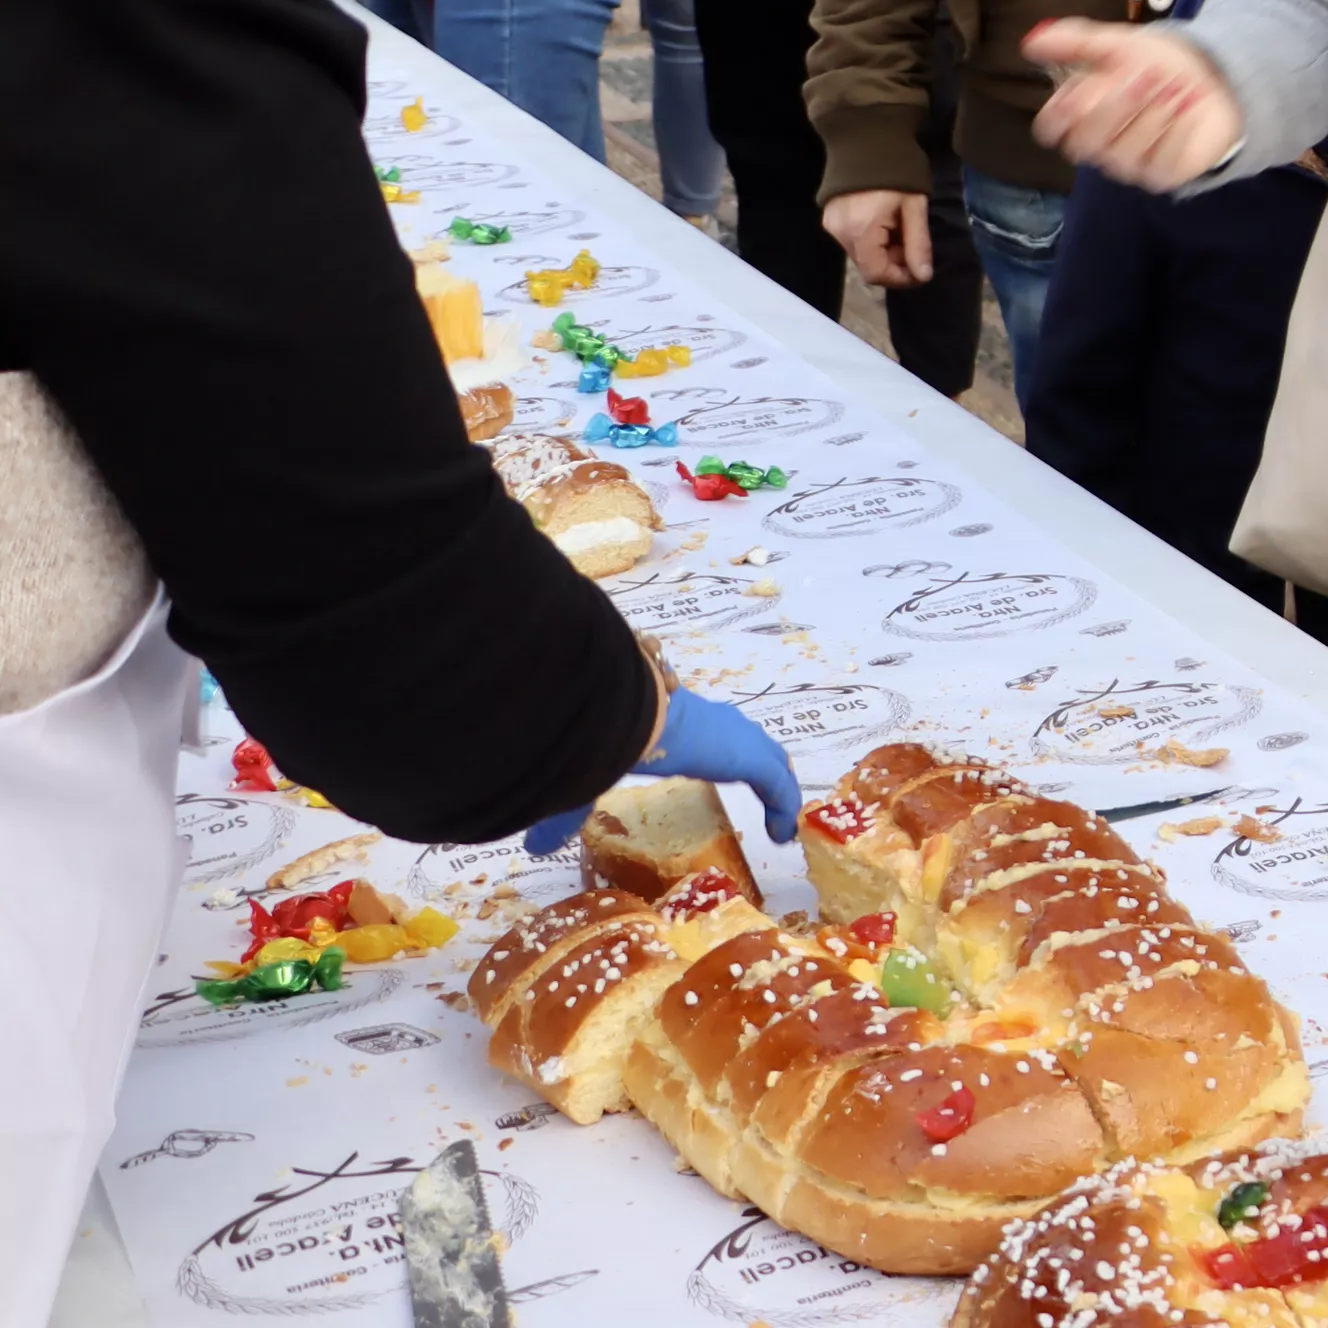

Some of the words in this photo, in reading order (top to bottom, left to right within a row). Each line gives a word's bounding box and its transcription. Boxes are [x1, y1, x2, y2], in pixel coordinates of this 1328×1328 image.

[863, 497, 886, 507] de
[791, 504, 856, 523] Araceli
[703, 587, 742, 599] Sra.
[1019, 586, 1058, 599] Sra.
[672, 597, 698, 607] de
[990, 596, 1016, 607] de
[620, 603, 665, 618] Arac
[651, 606, 701, 622] Ntra.
[914, 602, 983, 623] Araceli
[972, 604, 1022, 619] Ntra.
[825, 699, 868, 712] Sra.
[1145, 704, 1173, 714] de
[1177, 696, 1219, 708] Sra.
[792, 710, 821, 722] de
[1128, 713, 1181, 732] Ntra.
[771, 721, 826, 737] Ntra.
[1063, 711, 1137, 743] Araceli
[200, 815, 248, 835] Sra.
[274, 1225, 299, 1238] 500
[245, 1234, 269, 1246] 101
[329, 1233, 405, 1261] Nta.
[738, 1246, 829, 1285] raceli
